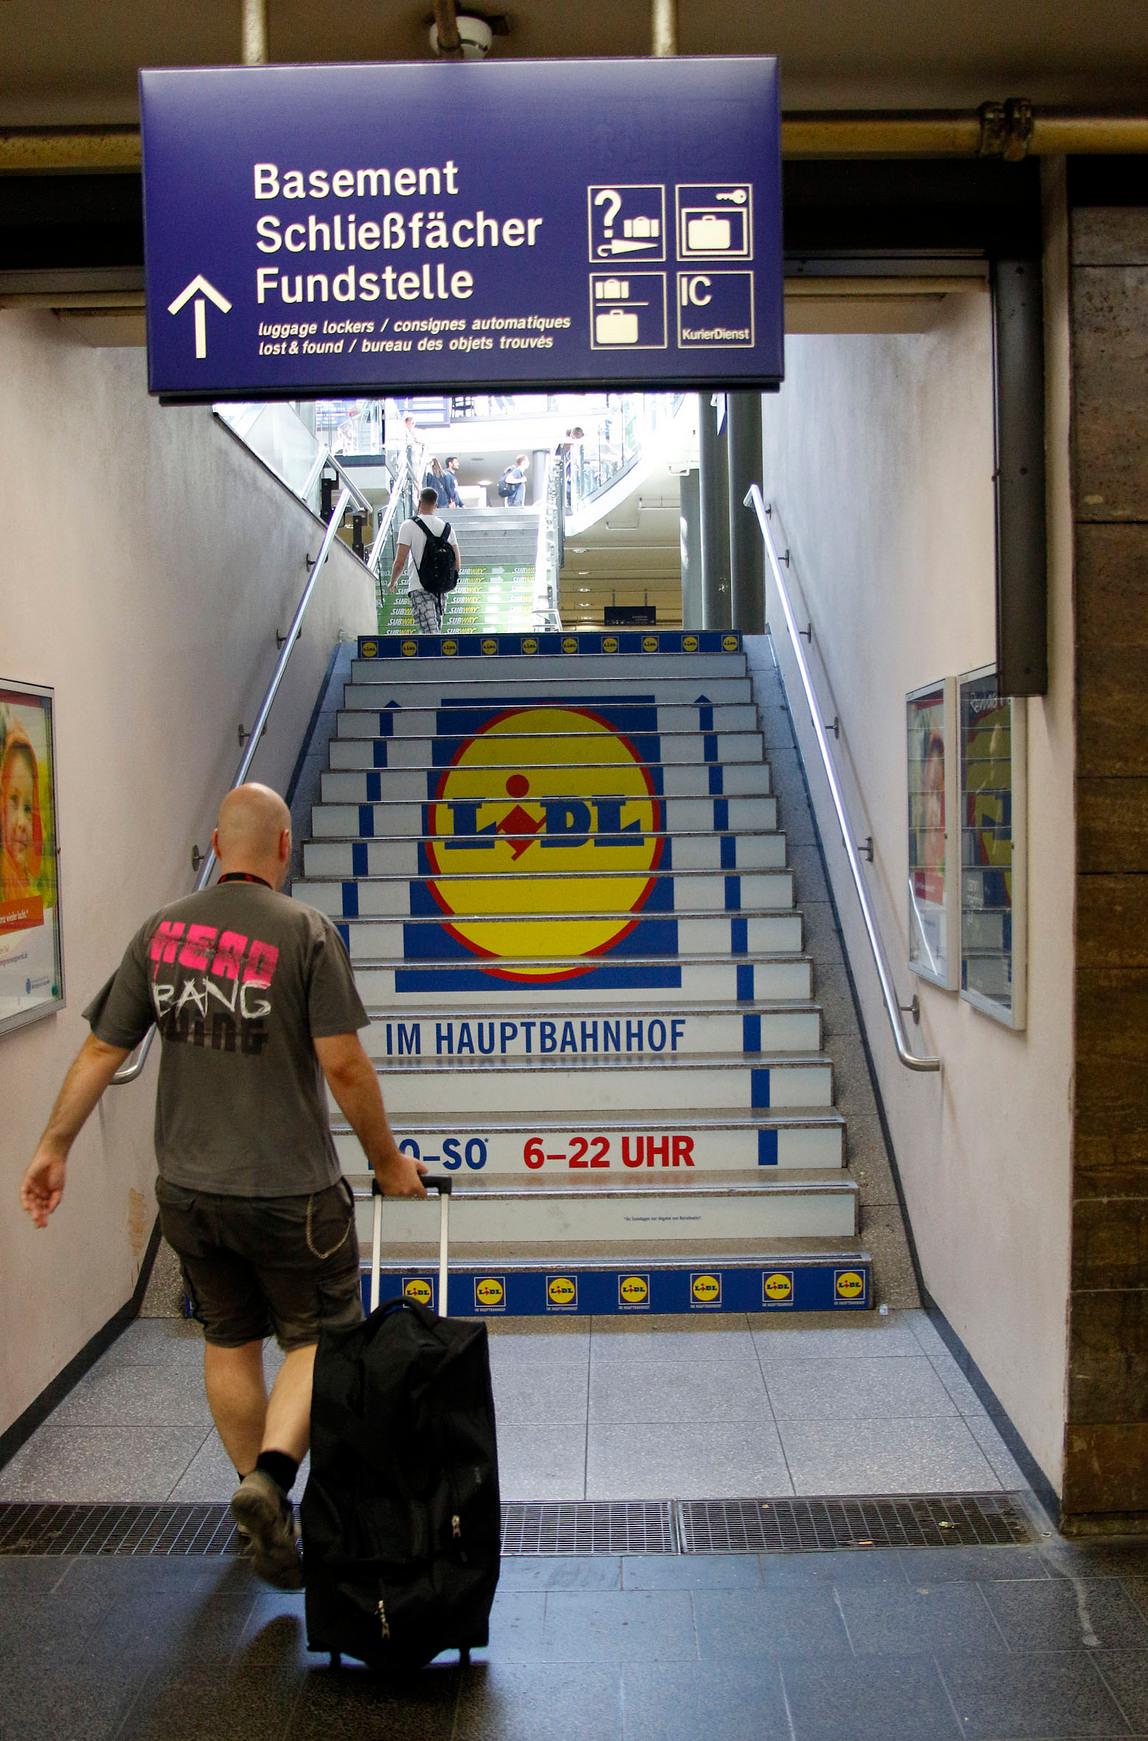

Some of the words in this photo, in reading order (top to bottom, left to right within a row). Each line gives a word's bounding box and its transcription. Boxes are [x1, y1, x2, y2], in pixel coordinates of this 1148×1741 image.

[253, 160, 459, 200] Basement
[255, 210, 544, 254] Schließfächer
[256, 263, 475, 304] Fundstelle
[681, 275, 713, 307] IC
[258, 320, 318, 339] luggage
[322, 319, 376, 335] lockers
[393, 316, 467, 335] consignes
[471, 314, 572, 333] automatiques
[361, 338, 413, 353] bureau
[417, 337, 444, 351] des
[449, 336, 494, 353] objets
[499, 334, 554, 349] trouvés
[682, 327, 750, 341] KurierDienst
[150, 920, 280, 984] HEAD
[151, 976, 272, 1019] BANG
[385, 1022, 421, 1056] IM
[435, 1019, 687, 1055] HAUPTBAHNHOF
[621, 1135, 696, 1168] UHR
